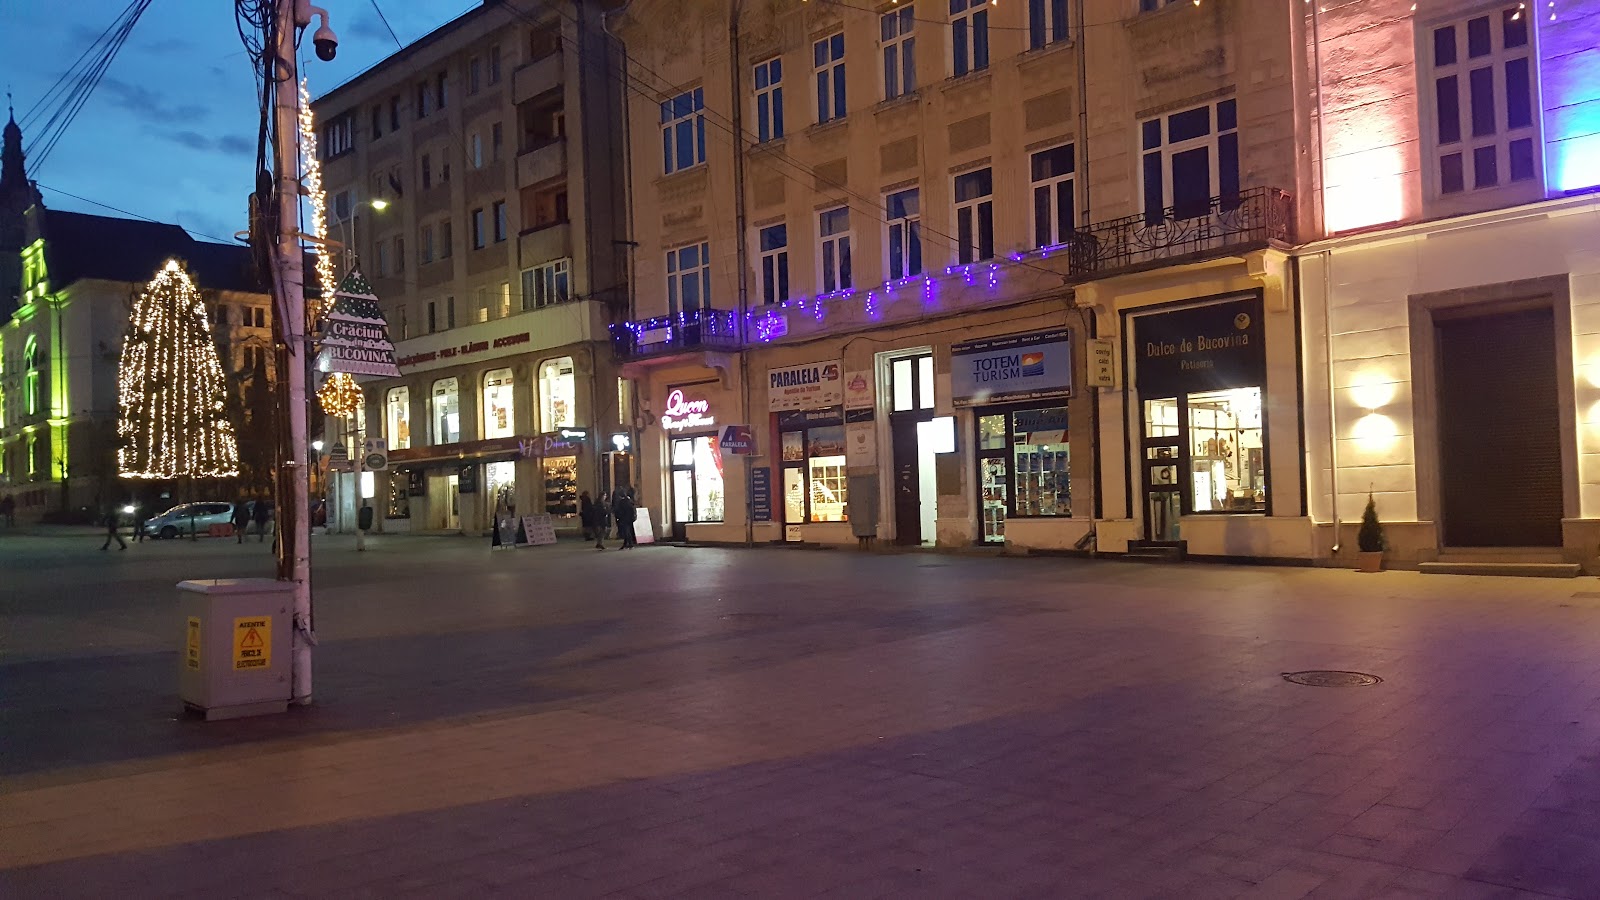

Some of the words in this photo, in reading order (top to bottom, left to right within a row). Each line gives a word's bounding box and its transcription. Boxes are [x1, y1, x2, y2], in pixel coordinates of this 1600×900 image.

[332, 322, 383, 339] Crăciun
[1147, 341, 1175, 357] Dulce
[1180, 338, 1193, 353] de
[1197, 333, 1249, 351] Bucovina
[328, 347, 388, 362] BUCOVINA
[973, 354, 1019, 371] TOTEM
[770, 367, 820, 389] PARALELA
[973, 367, 1020, 383] TURISM
[665, 389, 709, 416] Queen
